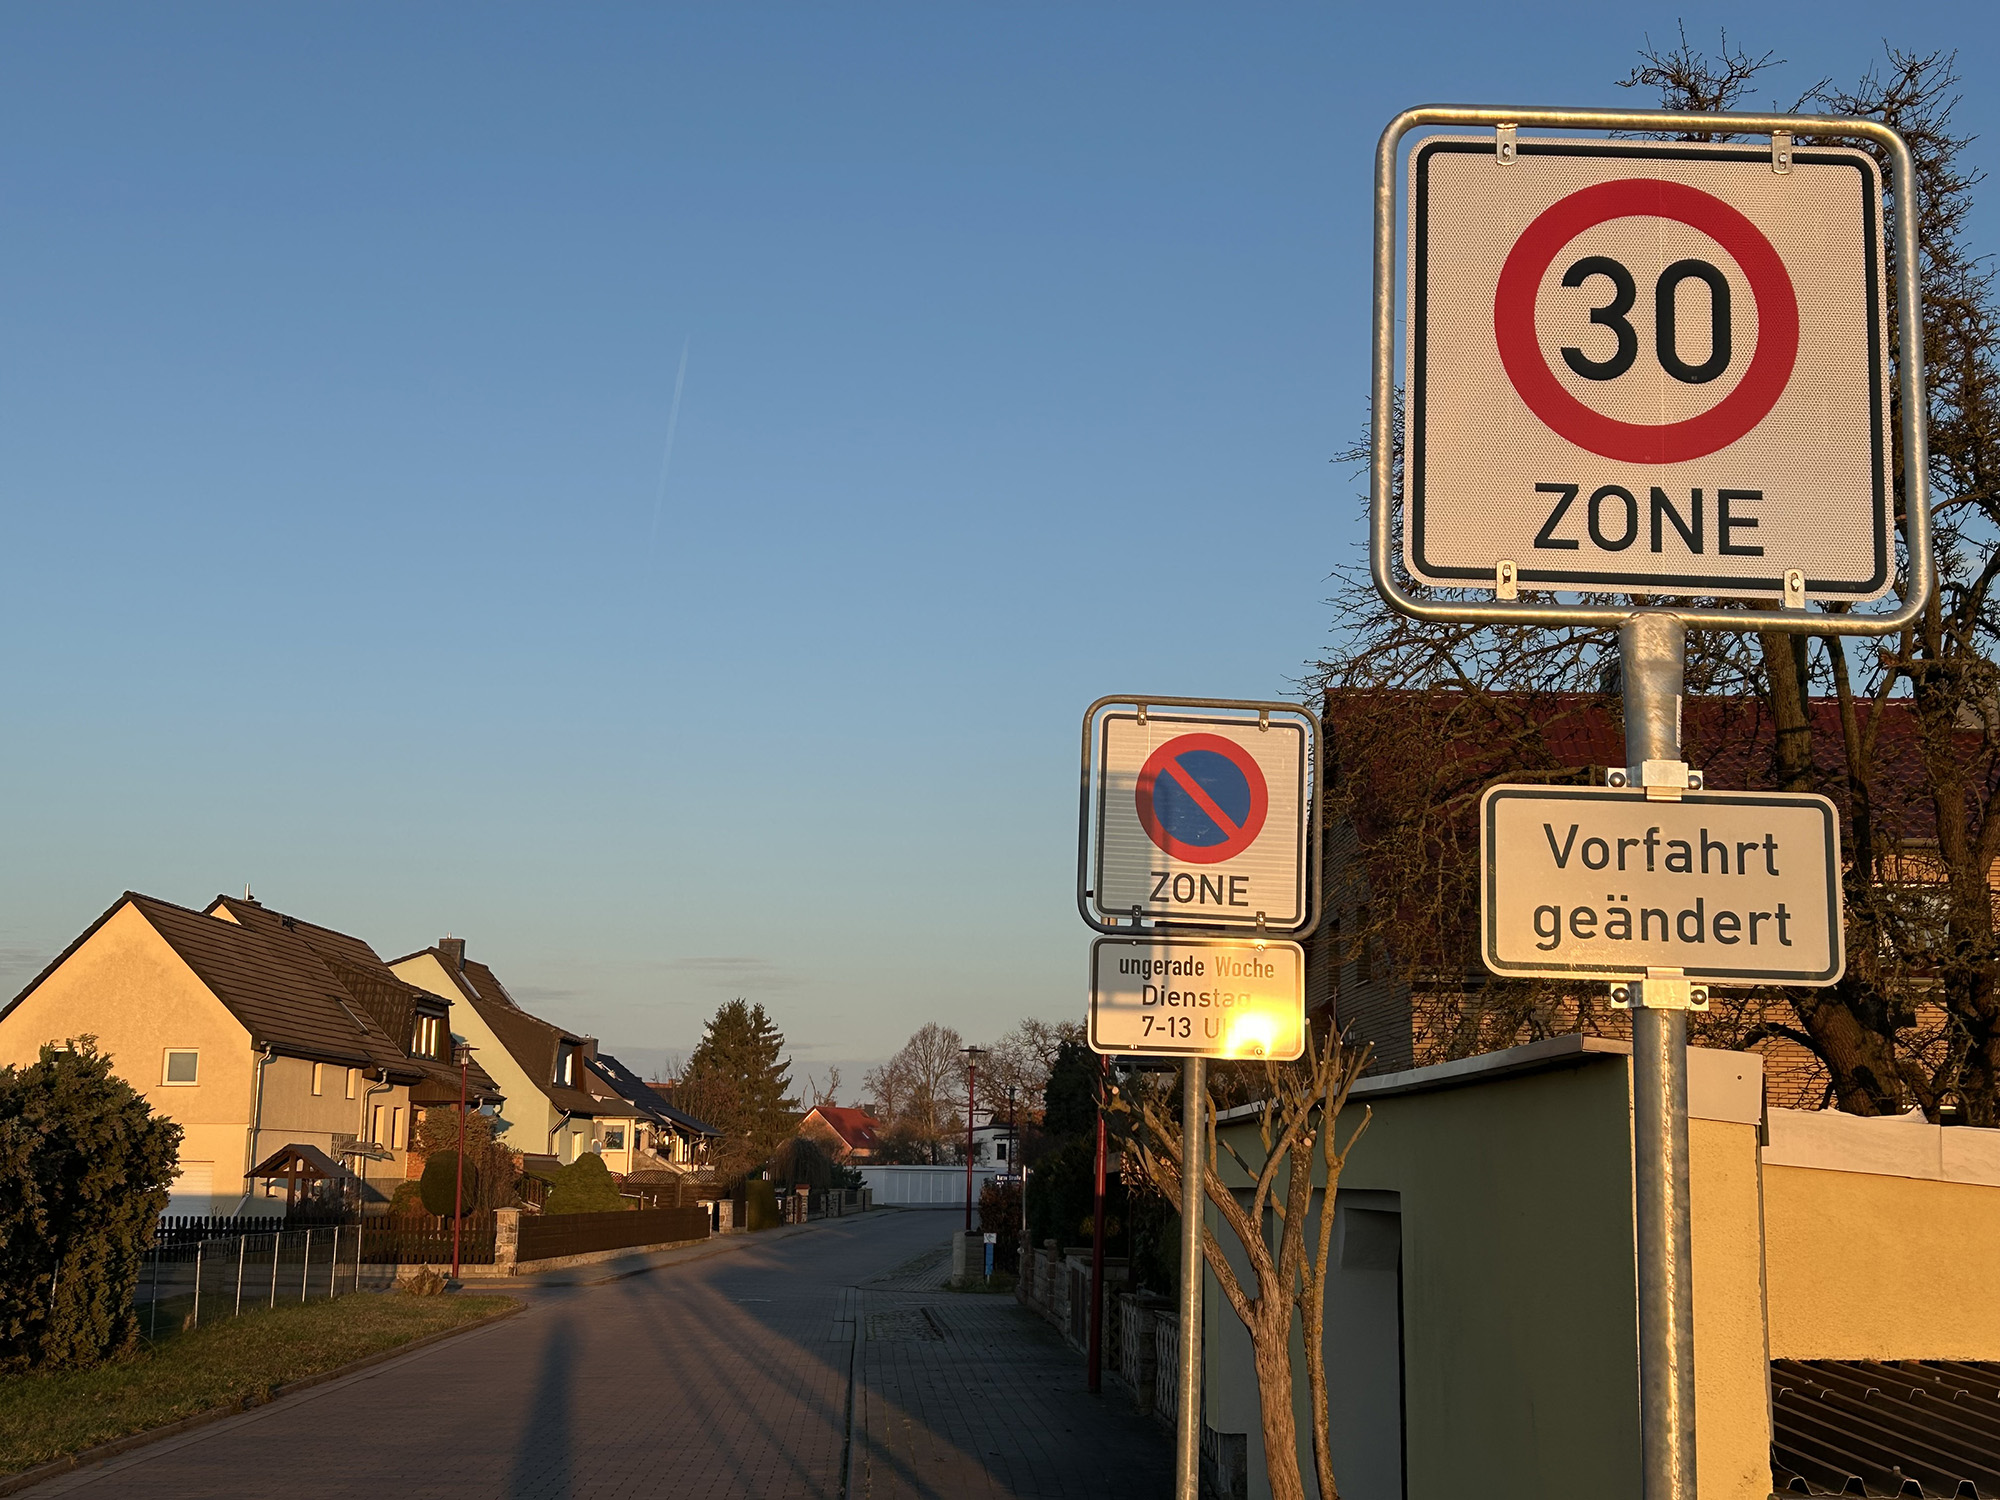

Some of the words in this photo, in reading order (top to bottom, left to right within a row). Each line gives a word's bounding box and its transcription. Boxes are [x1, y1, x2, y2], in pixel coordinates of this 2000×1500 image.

[1560, 255, 1731, 385] 30
[1534, 483, 1764, 556] ZONE
[1543, 823, 1779, 876] Vorfahrt
[1149, 871, 1250, 907] ZONE
[1533, 894, 1793, 951] geändert
[1119, 955, 1205, 980] ungerade
[1215, 956, 1275, 978] Woche
